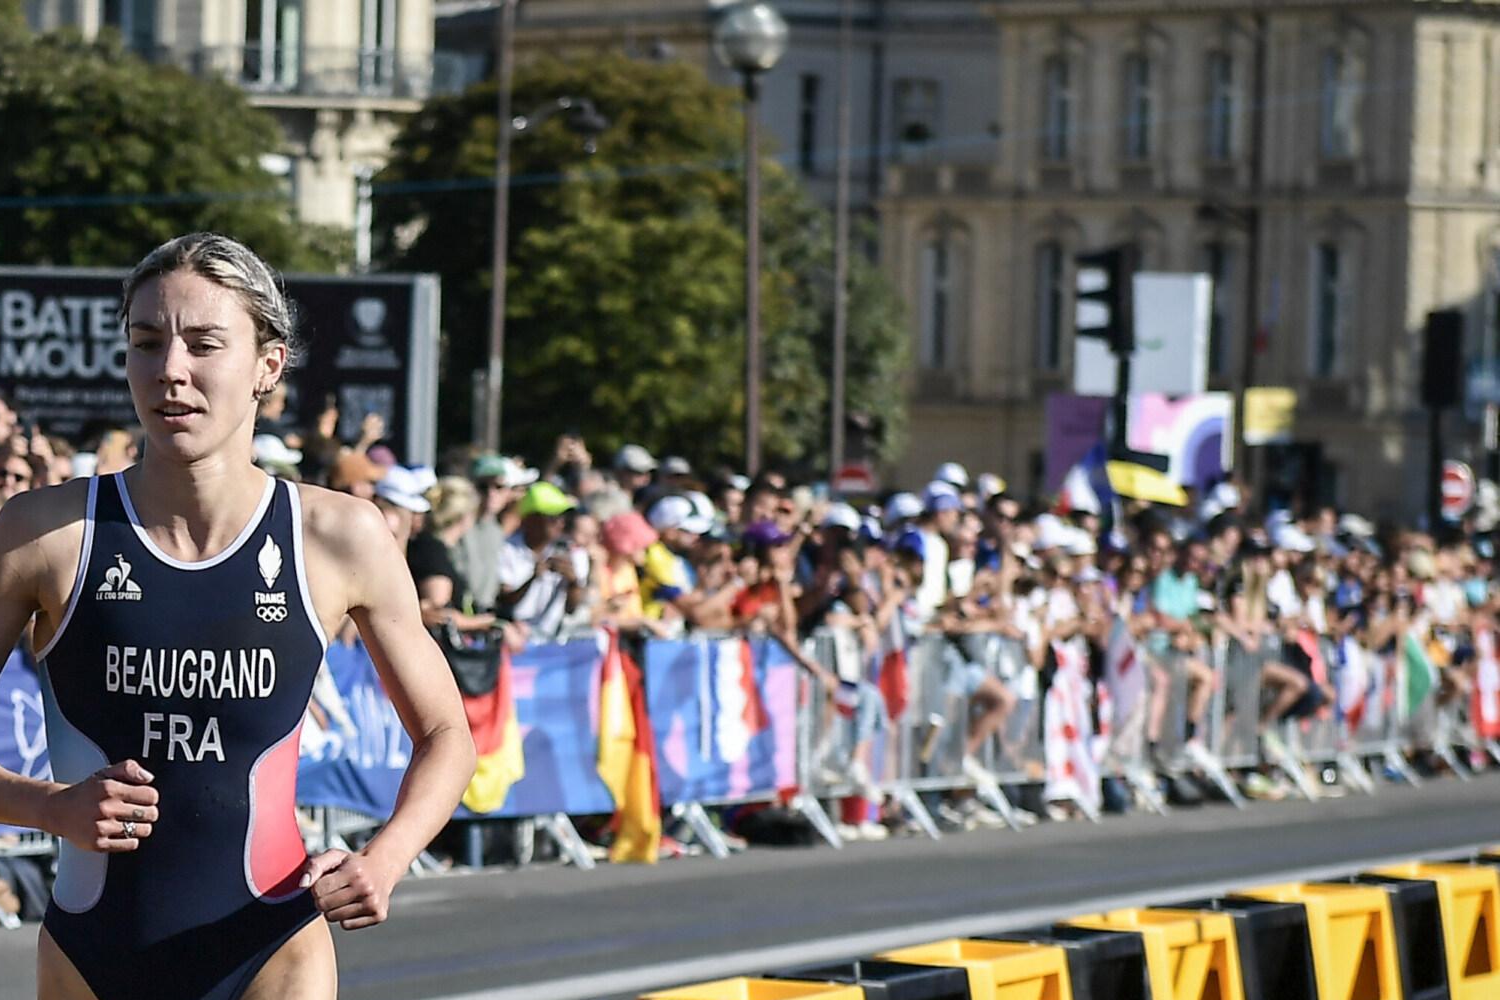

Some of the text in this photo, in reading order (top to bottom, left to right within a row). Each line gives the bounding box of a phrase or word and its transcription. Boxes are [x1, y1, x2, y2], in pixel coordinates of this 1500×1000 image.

[1, 290, 129, 338] BATE
[254, 591, 287, 605] FRANCE
[106, 645, 276, 699] BEAUGRAND
[142, 712, 226, 762] FRA
